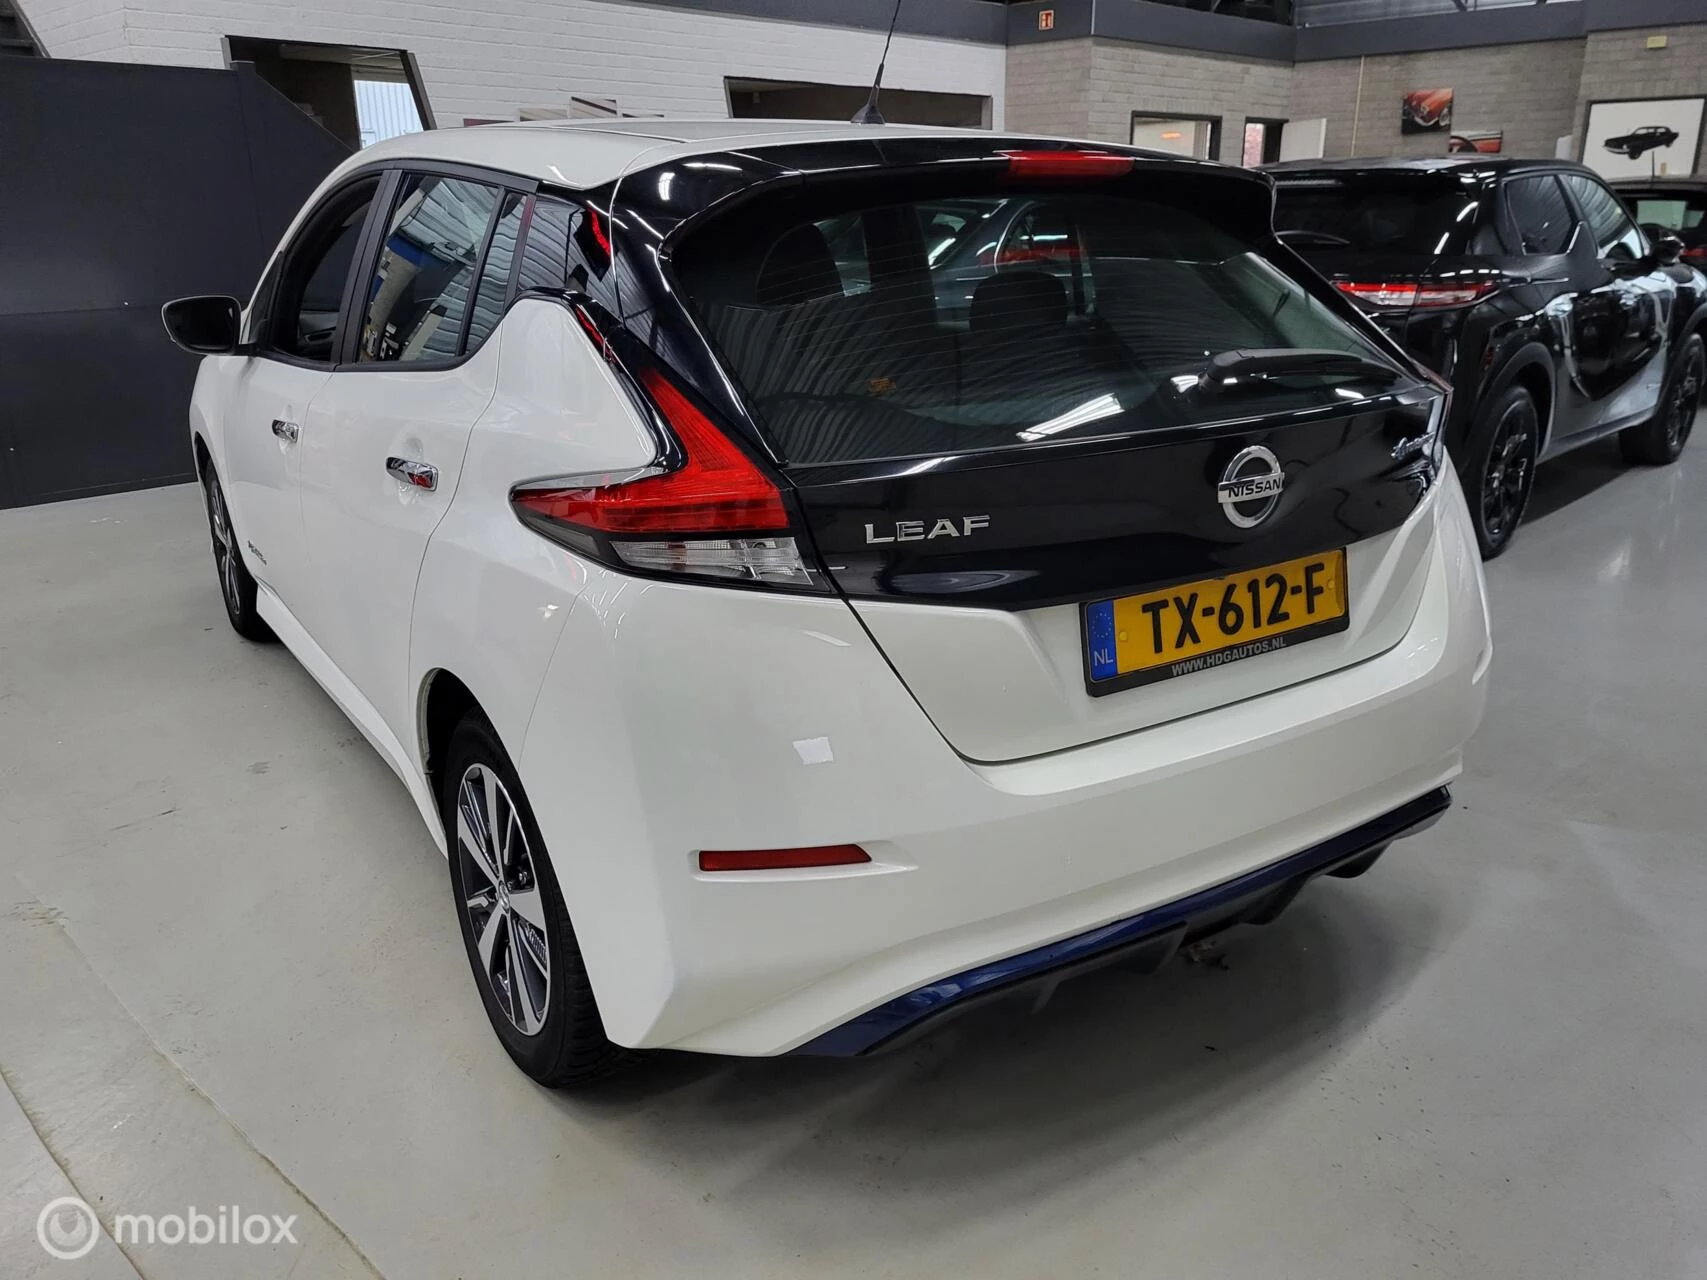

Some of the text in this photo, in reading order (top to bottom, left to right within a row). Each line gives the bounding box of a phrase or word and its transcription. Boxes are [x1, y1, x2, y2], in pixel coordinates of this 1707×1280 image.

[1228, 478, 1280, 498] NISSAN
[865, 515, 990, 544] LEAF
[1142, 563, 1325, 654] TX-612-F
[1094, 648, 1114, 666] NL
[1172, 636, 1287, 677] WWW.HDGAUTOS.NL
